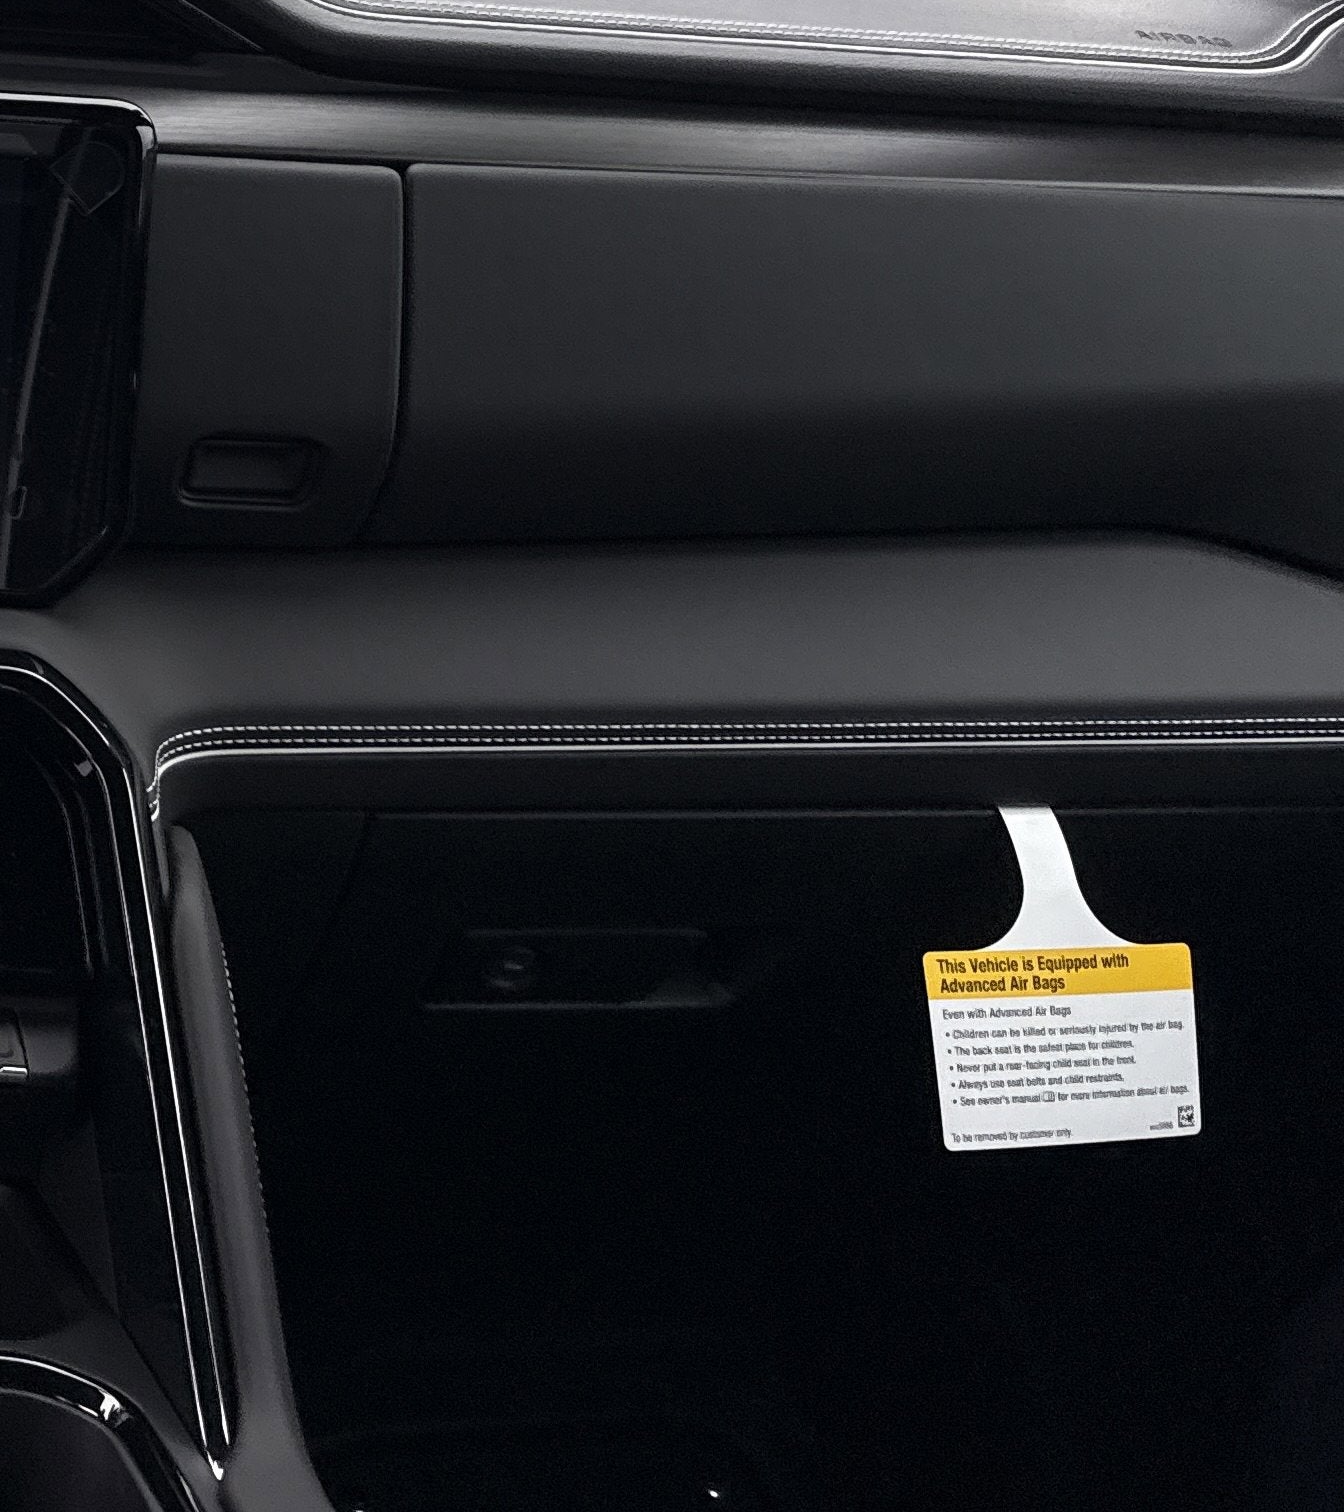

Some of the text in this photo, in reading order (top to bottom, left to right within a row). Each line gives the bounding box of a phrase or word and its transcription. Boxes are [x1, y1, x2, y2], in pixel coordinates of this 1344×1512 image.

[937, 953, 1129, 974] This Vehicle is Equipped with
[940, 975, 1065, 994] Advanced Air Bags
[942, 1005, 1072, 1020] Even with Advanced Air Bags
